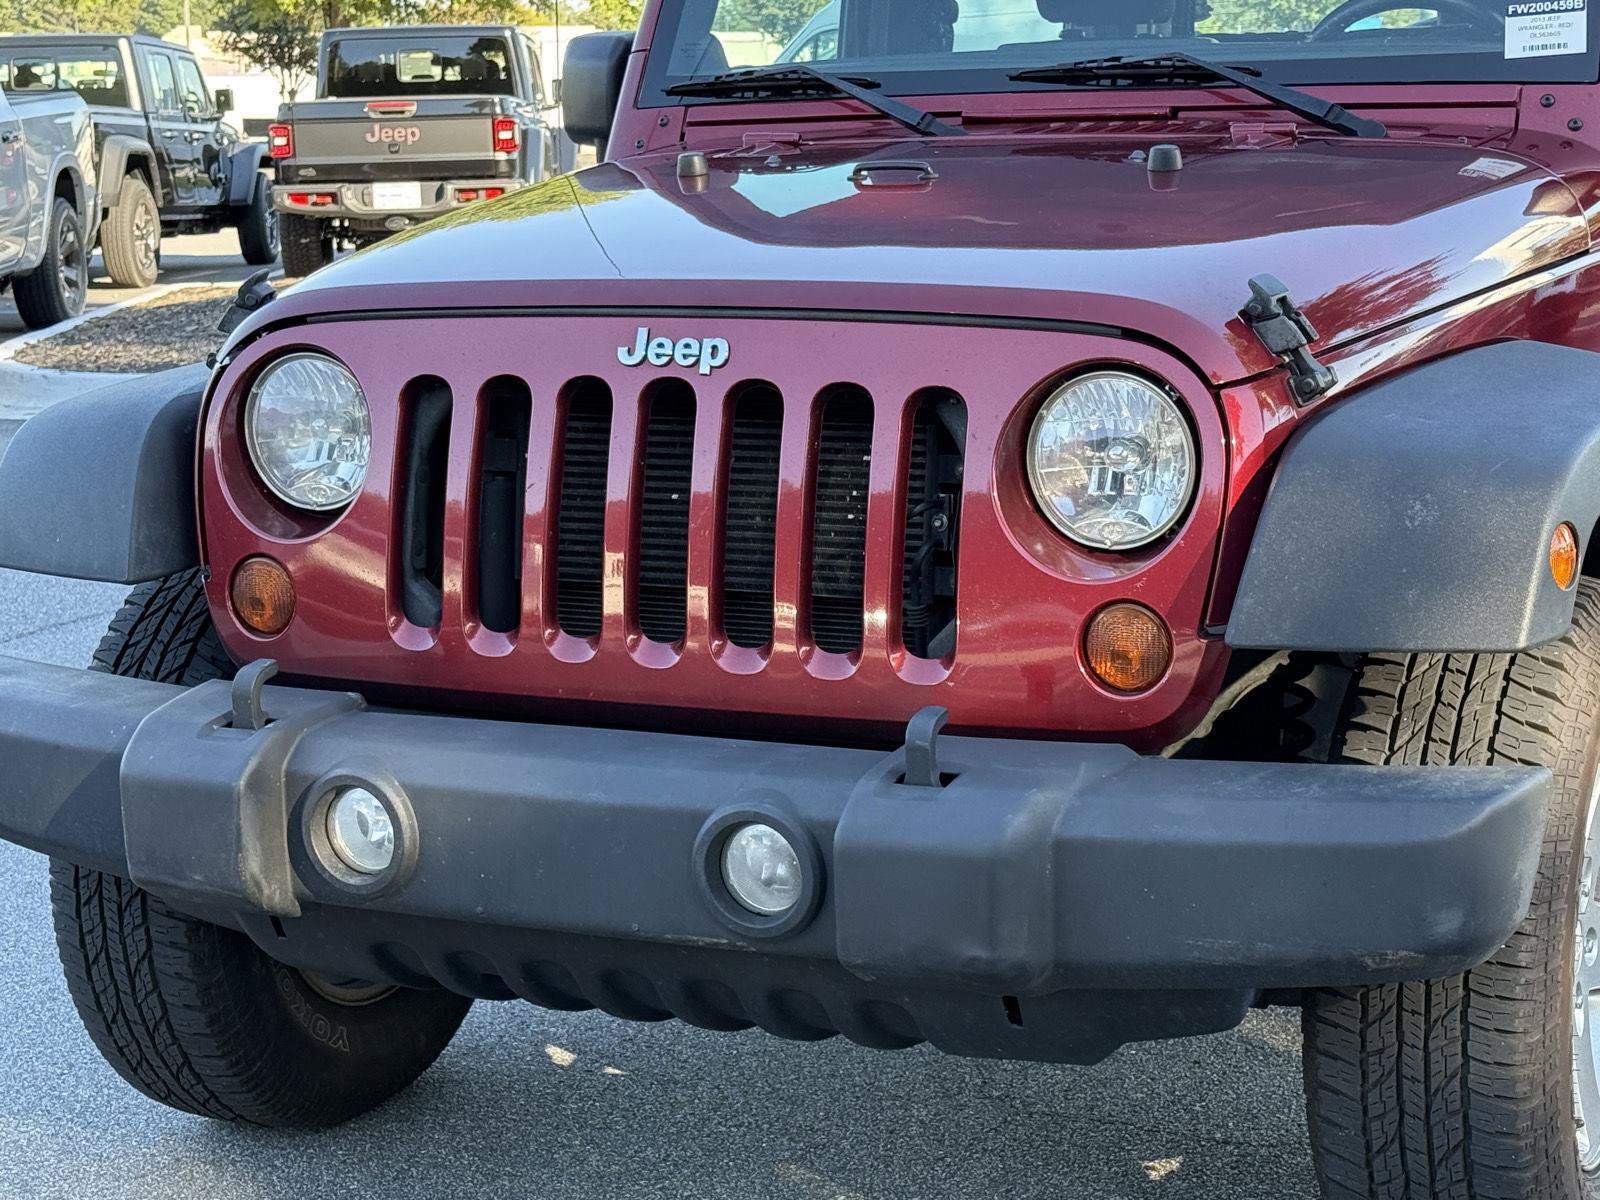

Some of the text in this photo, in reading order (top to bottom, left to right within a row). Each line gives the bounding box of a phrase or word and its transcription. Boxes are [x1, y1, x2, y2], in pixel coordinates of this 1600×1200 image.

[1508, 0, 1584, 15] FW200459B
[1517, 23, 1553, 31] WRANGLER
[365, 123, 420, 145] Jeep
[617, 326, 730, 376] Jeep
[272, 962, 350, 1052] YOKO
